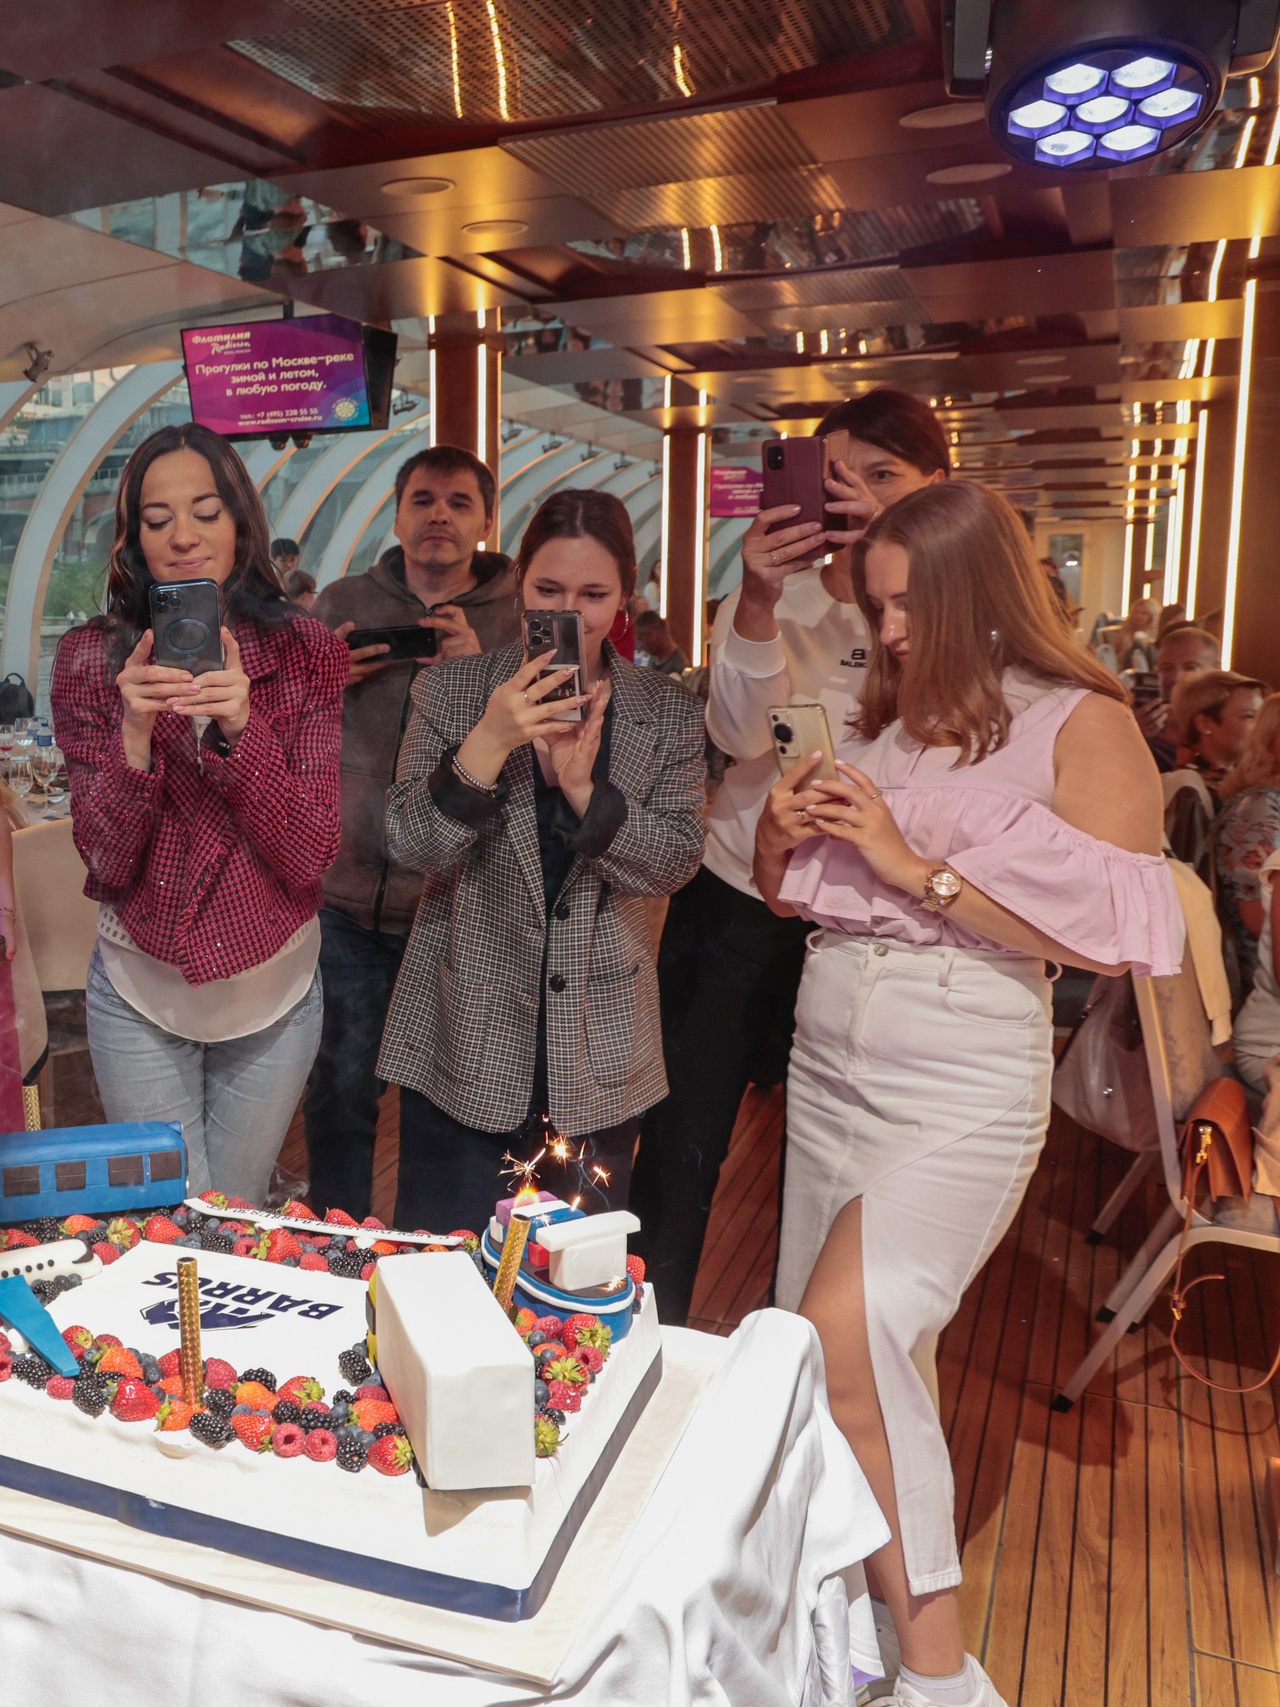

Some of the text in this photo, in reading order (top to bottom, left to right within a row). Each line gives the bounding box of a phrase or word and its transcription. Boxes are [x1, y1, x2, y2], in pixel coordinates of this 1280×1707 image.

[195, 352, 355, 376] Прогулки по Москве-реке
[230, 369, 319, 384] зимой и летом,
[226, 380, 327, 396] в любую погоду.
